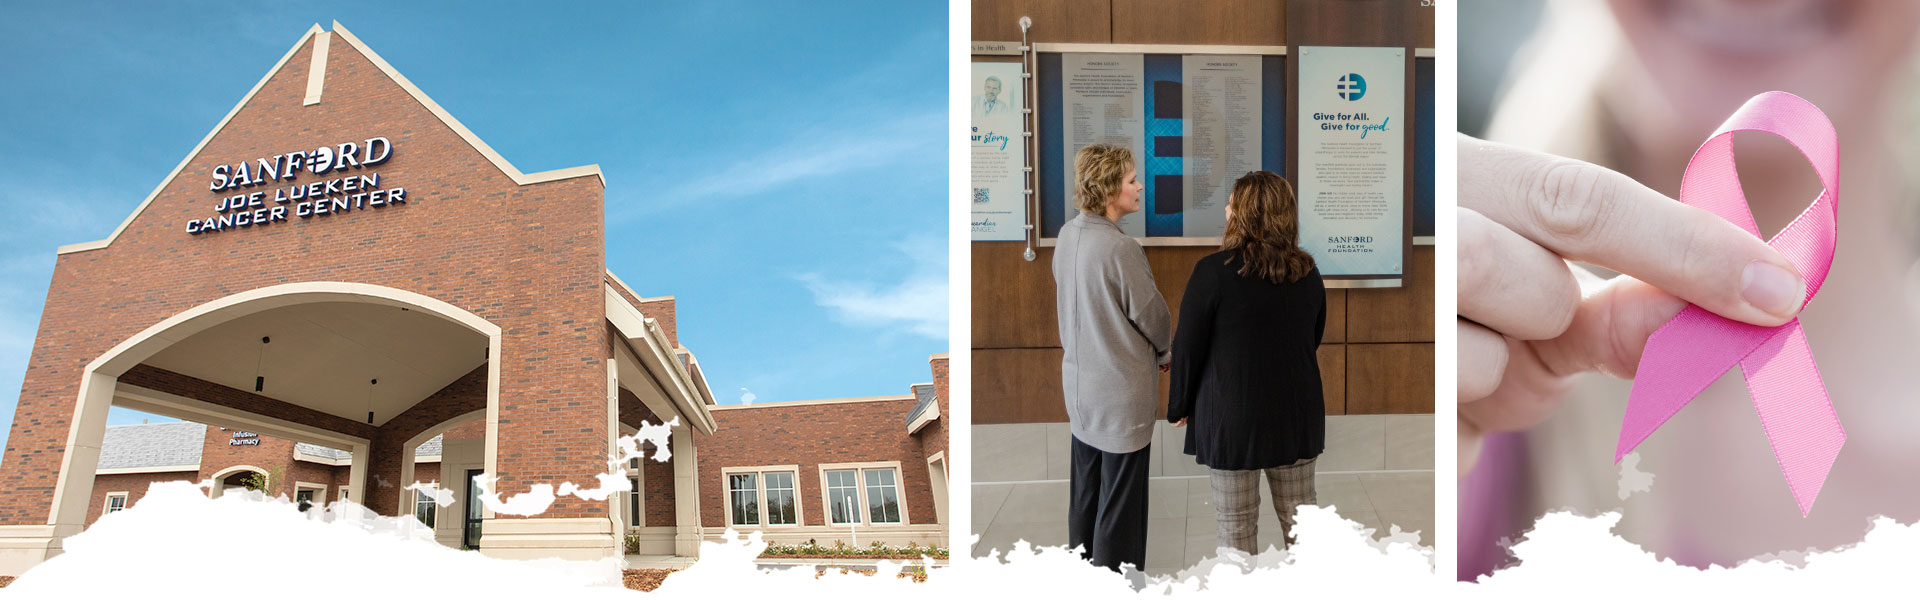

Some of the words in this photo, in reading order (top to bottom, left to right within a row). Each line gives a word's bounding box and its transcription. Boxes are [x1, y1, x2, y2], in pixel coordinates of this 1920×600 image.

[1313, 112, 1335, 121] Give
[1337, 112, 1351, 121] for
[1353, 112, 1370, 121] All.
[1321, 122, 1343, 130] Give
[1346, 122, 1360, 130] for
[983, 131, 1009, 151] story
[210, 136, 394, 193] SANFORD
[214, 191, 267, 213] JOE
[274, 172, 381, 203] LUEKEN
[185, 205, 289, 236] CANCER
[296, 187, 407, 220] CENTER
[229, 438, 261, 446] Pharmacy
